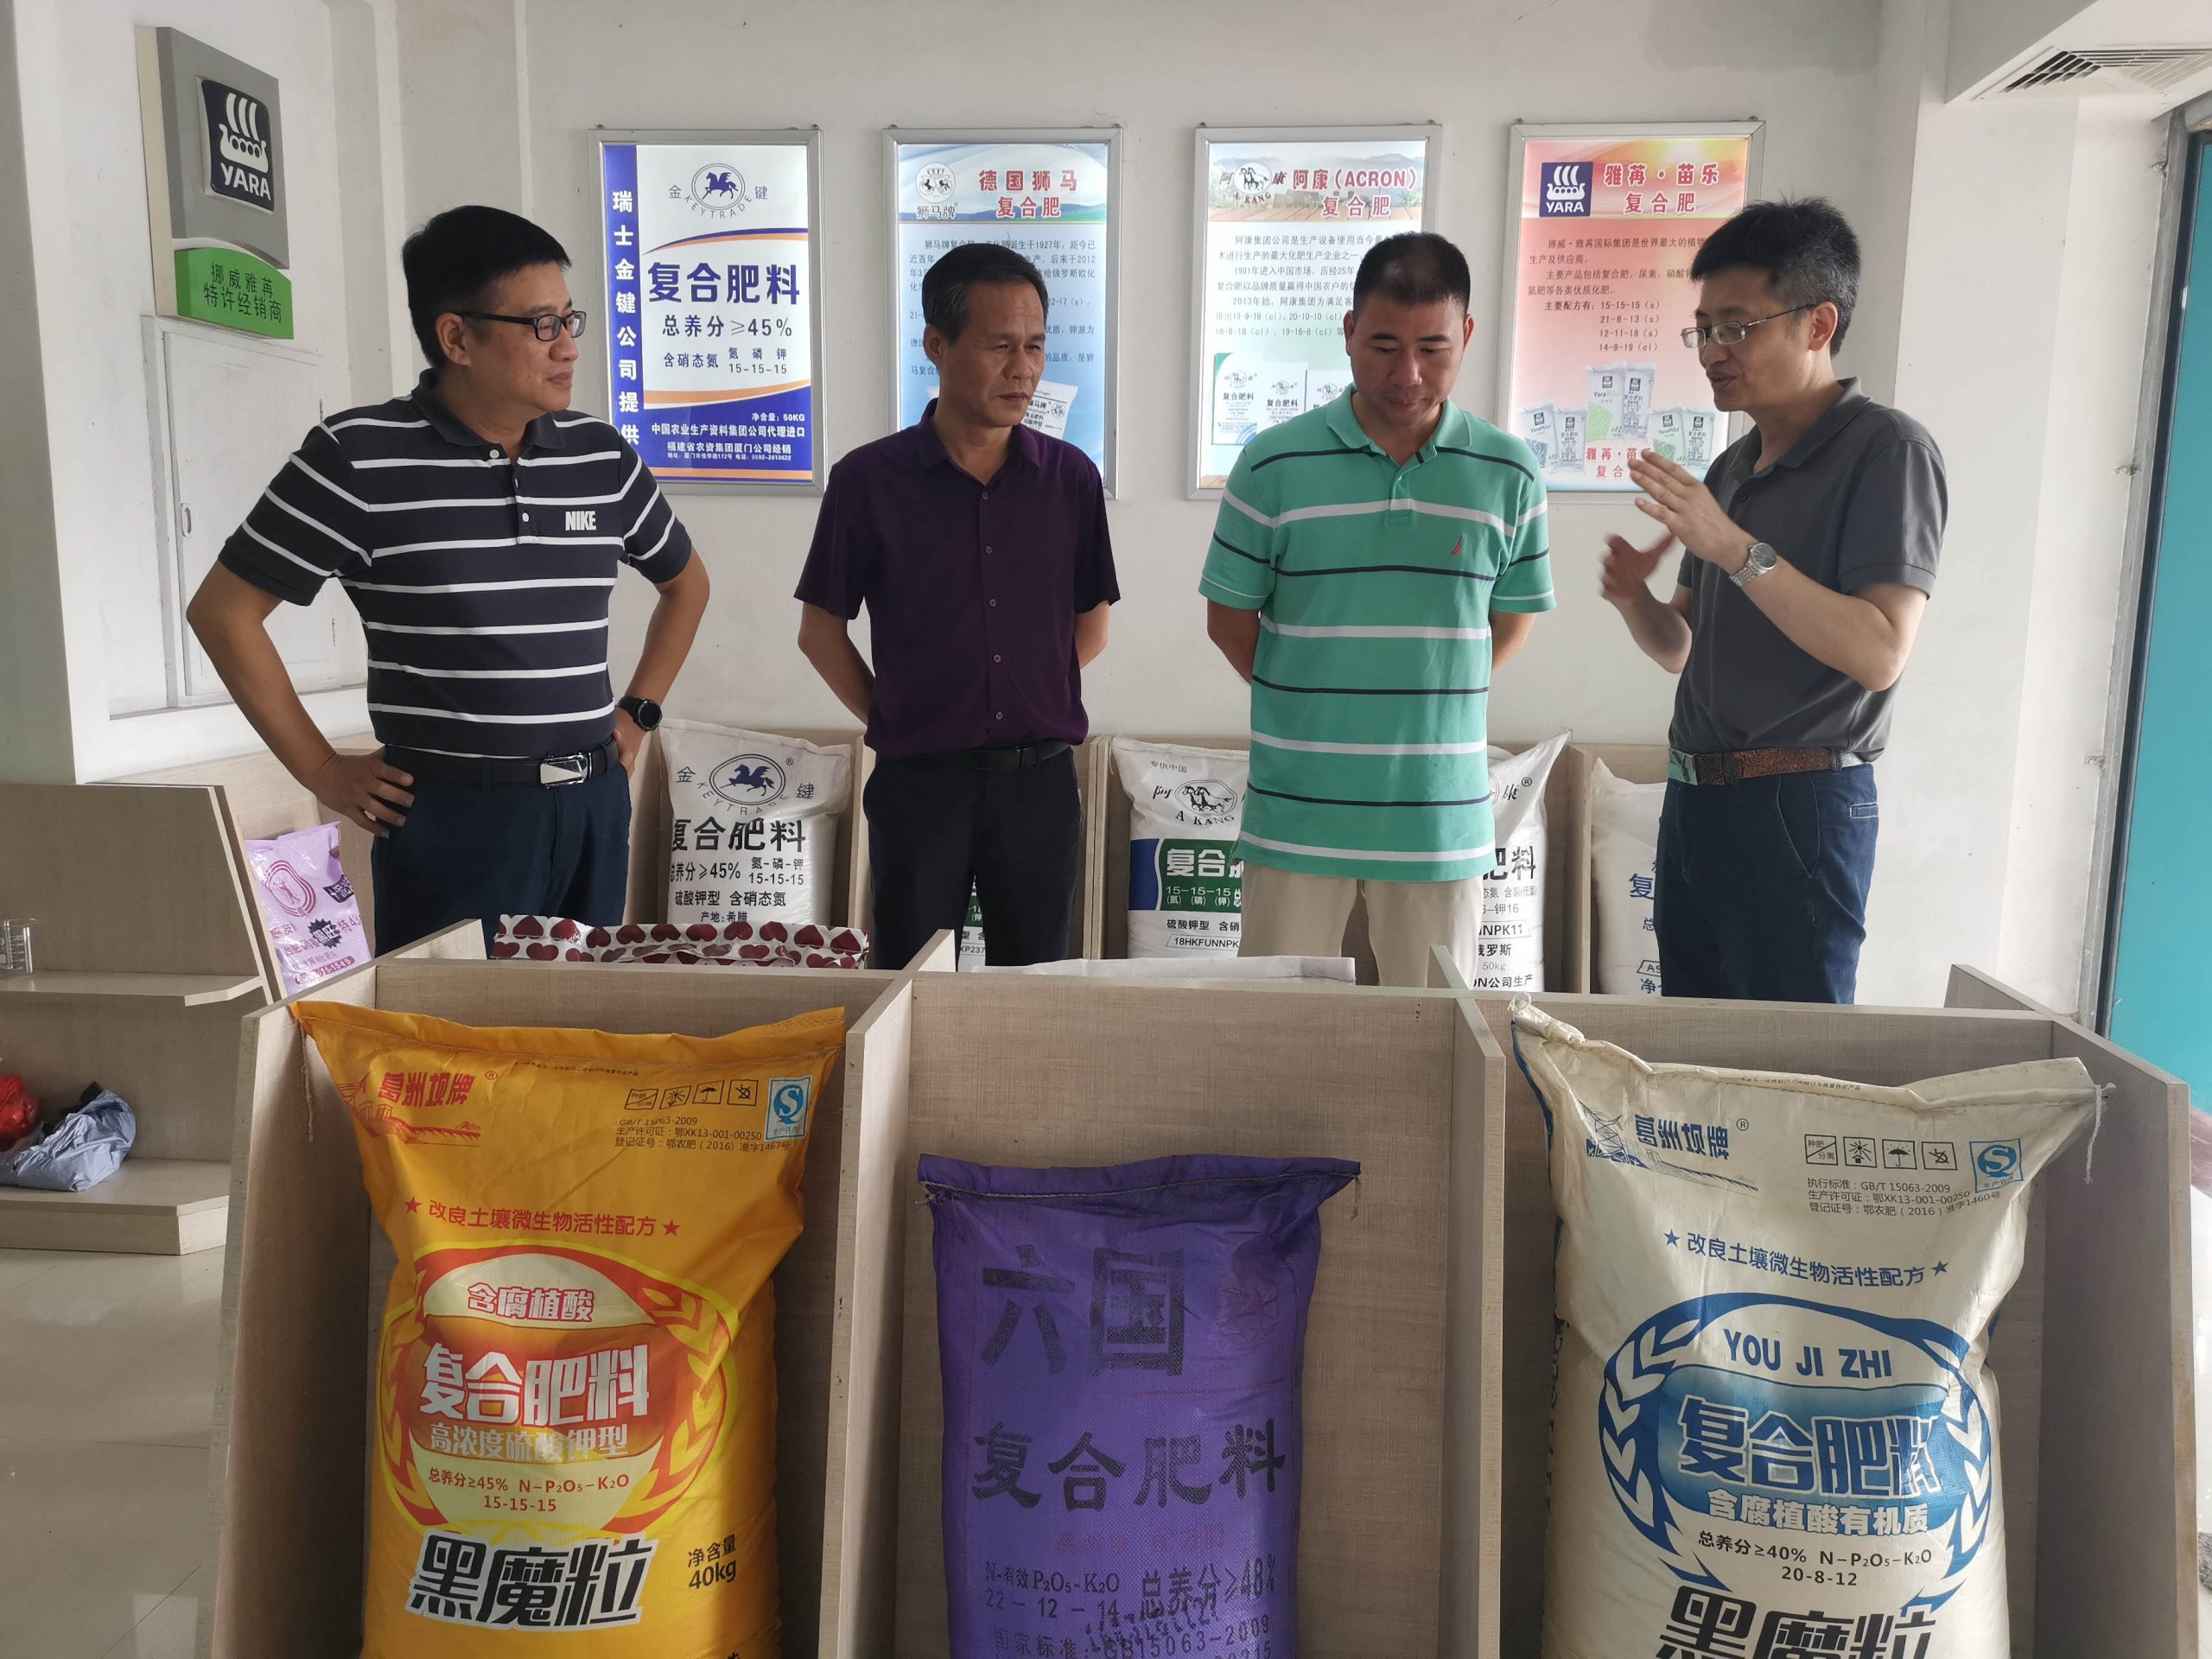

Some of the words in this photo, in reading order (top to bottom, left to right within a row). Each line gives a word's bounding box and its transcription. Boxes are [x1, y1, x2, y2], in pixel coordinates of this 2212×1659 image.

[220, 162, 271, 200] YARA
[978, 169, 1077, 192] 德国狮马
[668, 185, 682, 200] 金
[755, 185, 768, 200] 键
[1244, 191, 1272, 205] KANG
[1624, 192, 1696, 214] 复合肥
[684, 194, 753, 219] KEYTRADE
[916, 206, 957, 219] 狮马牌
[996, 196, 1062, 218] 复合肥
[1322, 196, 1391, 217] 复合肥
[1544, 201, 1585, 213] YARA
[210, 262, 274, 298] 挪威雅苒
[647, 262, 800, 306] 复合肥料
[203, 282, 283, 323] 特许经销商
[612, 190, 640, 448] 瑞士金键公司提供
[662, 314, 792, 338] 总养分≥45%
[663, 352, 719, 369] 含硝态氮
[728, 363, 787, 374] 15-15-15
[652, 422, 805, 438] 中国农业生产资料集团公司代理进口
[666, 441, 791, 454] 福建省农资集团厦门公司经销
[1596, 465, 1633, 478] 复合
[565, 511, 597, 531] NIKE
[1149, 760, 1187, 774] 专供中国
[677, 766, 696, 784] 金
[795, 782, 816, 800] 键
[1175, 810, 1185, 823] A
[1192, 815, 1235, 826] KANG
[671, 816, 806, 853] 复合肥料
[751, 856, 804, 872] 氮-磷-钾
[748, 873, 804, 886] 15-15-15
[1628, 873, 1655, 900] 复
[675, 890, 721, 906] 硫酸钾型
[728, 890, 787, 907] 含硝态氮
[1166, 887, 1232, 898] 15-15-15
[1166, 919, 1210, 931] 硫酸钾型
[1219, 920, 1240, 932] 含硝
[1173, 937, 1240, 949] 18HKFUNNPK
[1483, 961, 1506, 971] 50kg
[1640, 977, 1662, 994] 净
[1807, 1139, 1825, 1148] 种肥
[1818, 1151, 1835, 1160] 分离
[1890, 1183, 1951, 1193] 15063-2009
[428, 1198, 658, 1238] 改良土壤微生物活性配方
[1687, 1231, 1925, 1287] 改良土壤微生物活性配方
[467, 1282, 595, 1323] 含腐植酸
[980, 1243, 1185, 1377] 六国
[1723, 1328, 1781, 1371] YOU
[1796, 1350, 1824, 1377] JI
[1840, 1349, 1892, 1379] ZHI
[418, 1341, 651, 1427] 复合肥料
[429, 1422, 630, 1462] 高浓度硫酸钾型
[1679, 1395, 1942, 1499] 复合肥料
[971, 1417, 1287, 1512] 复合肥料
[428, 1467, 509, 1492] 总养分≥45%
[483, 1494, 557, 1513] 15-15-15
[1707, 1488, 1929, 1536] 含腐植酸有机质
[688, 1534, 736, 1568] 净含量
[1698, 1530, 1808, 1564] 总养分≥40%
[408, 1532, 657, 1629] 黑魔粒
[688, 1560, 737, 1590] 40kg
[1781, 1566, 1858, 1587] 20-8-12
